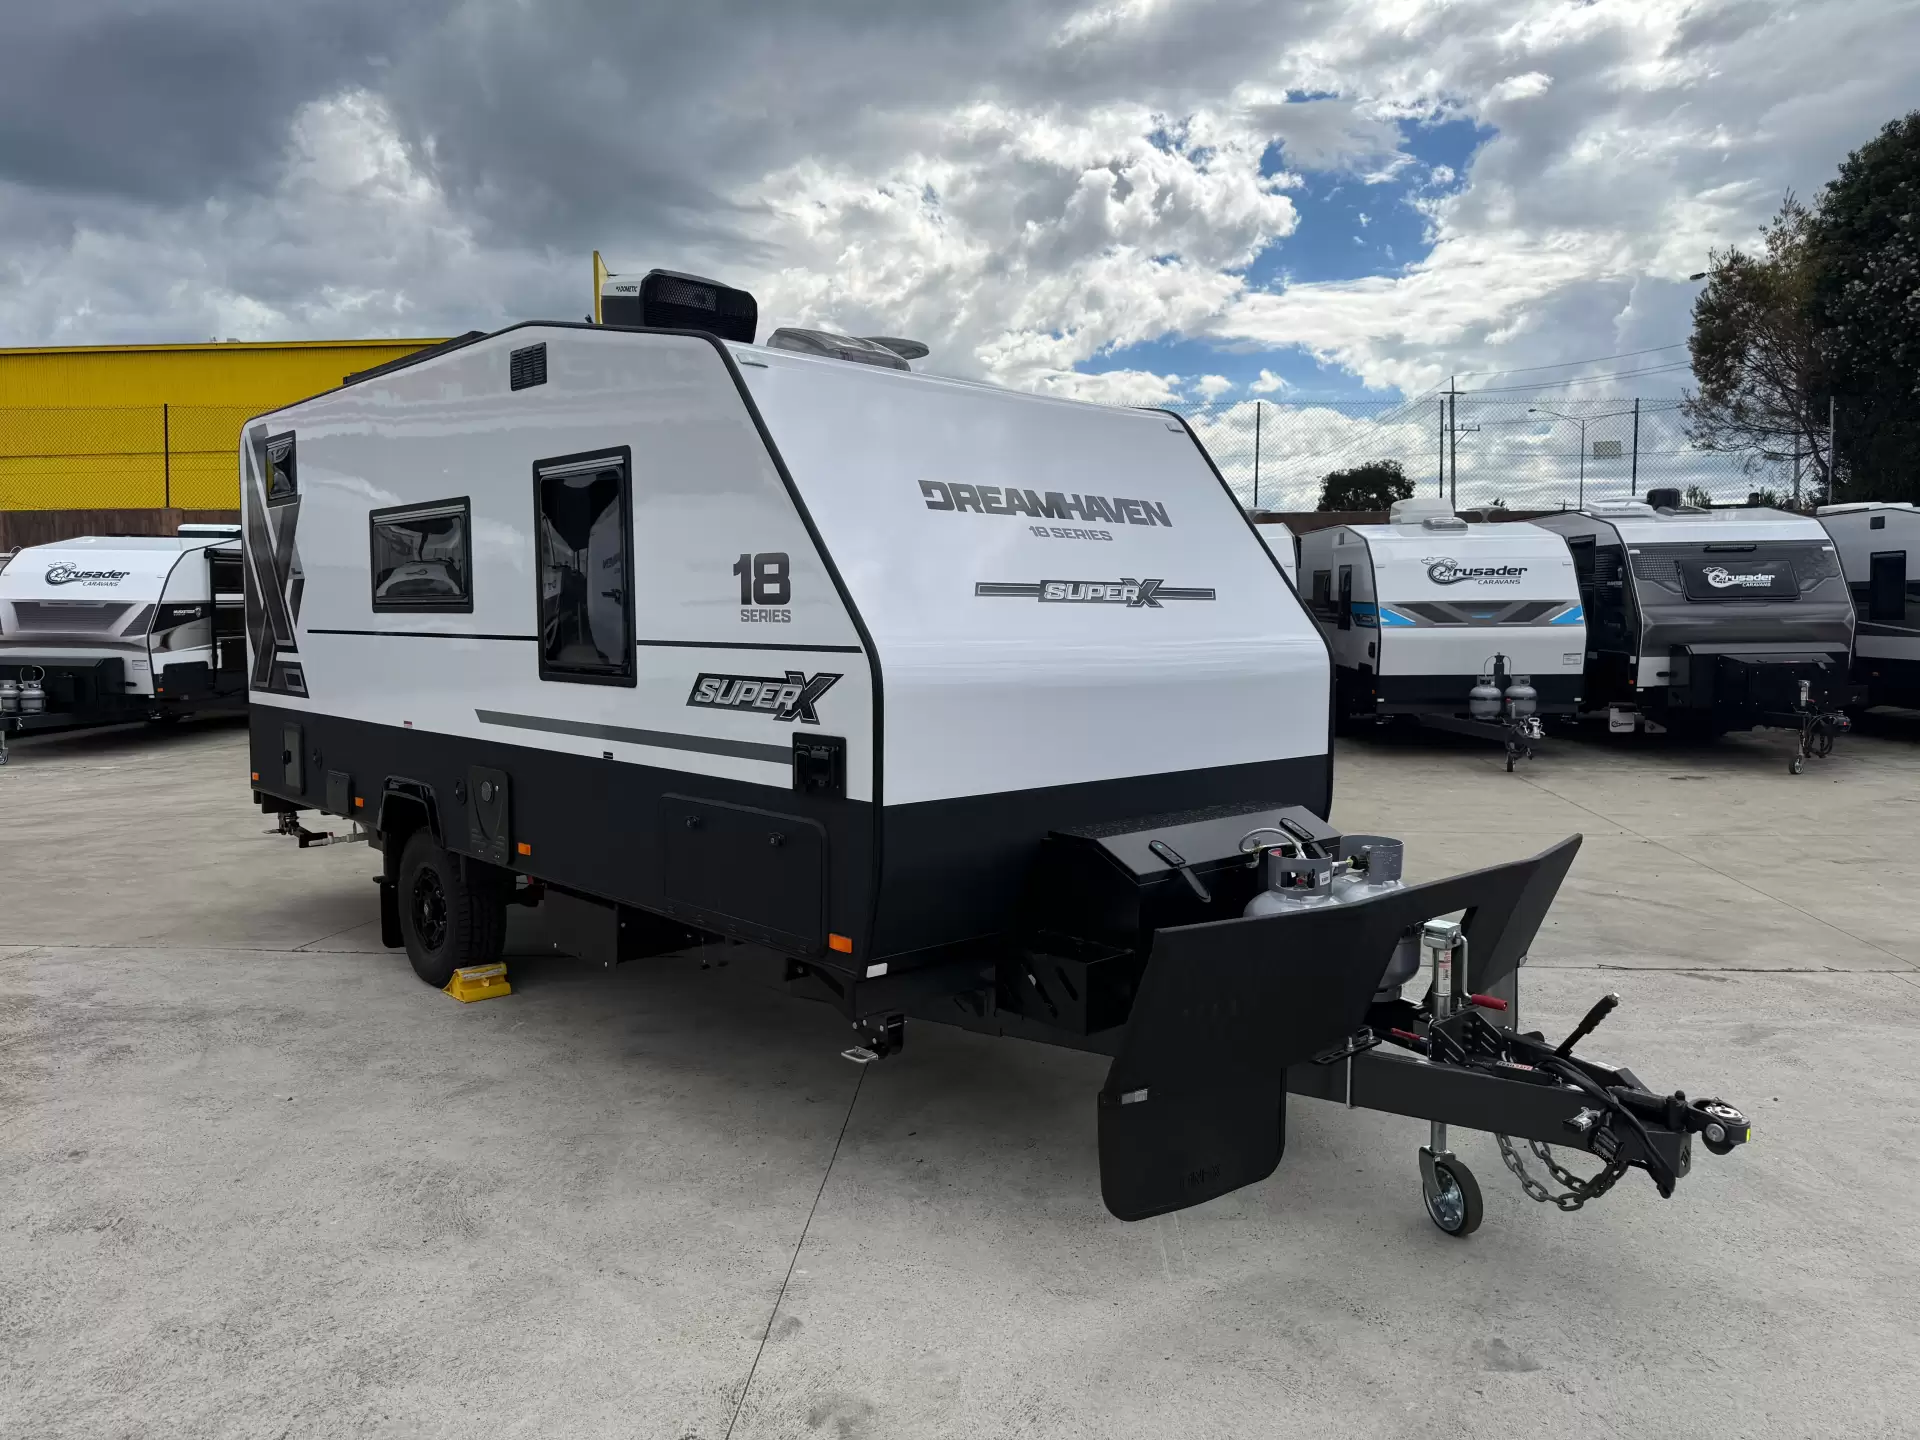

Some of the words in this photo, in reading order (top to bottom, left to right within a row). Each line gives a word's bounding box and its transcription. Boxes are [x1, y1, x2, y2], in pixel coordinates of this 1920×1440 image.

[918, 479, 1173, 528] DREAMHAVEN
[1029, 525, 1050, 538] 18
[1050, 528, 1113, 541] SERIES
[45, 565, 131, 586] Crusader
[733, 552, 791, 606] 18
[1427, 562, 1528, 586] Crusader
[1707, 571, 1776, 588] Crusader
[740, 608, 792, 623] SERIES
